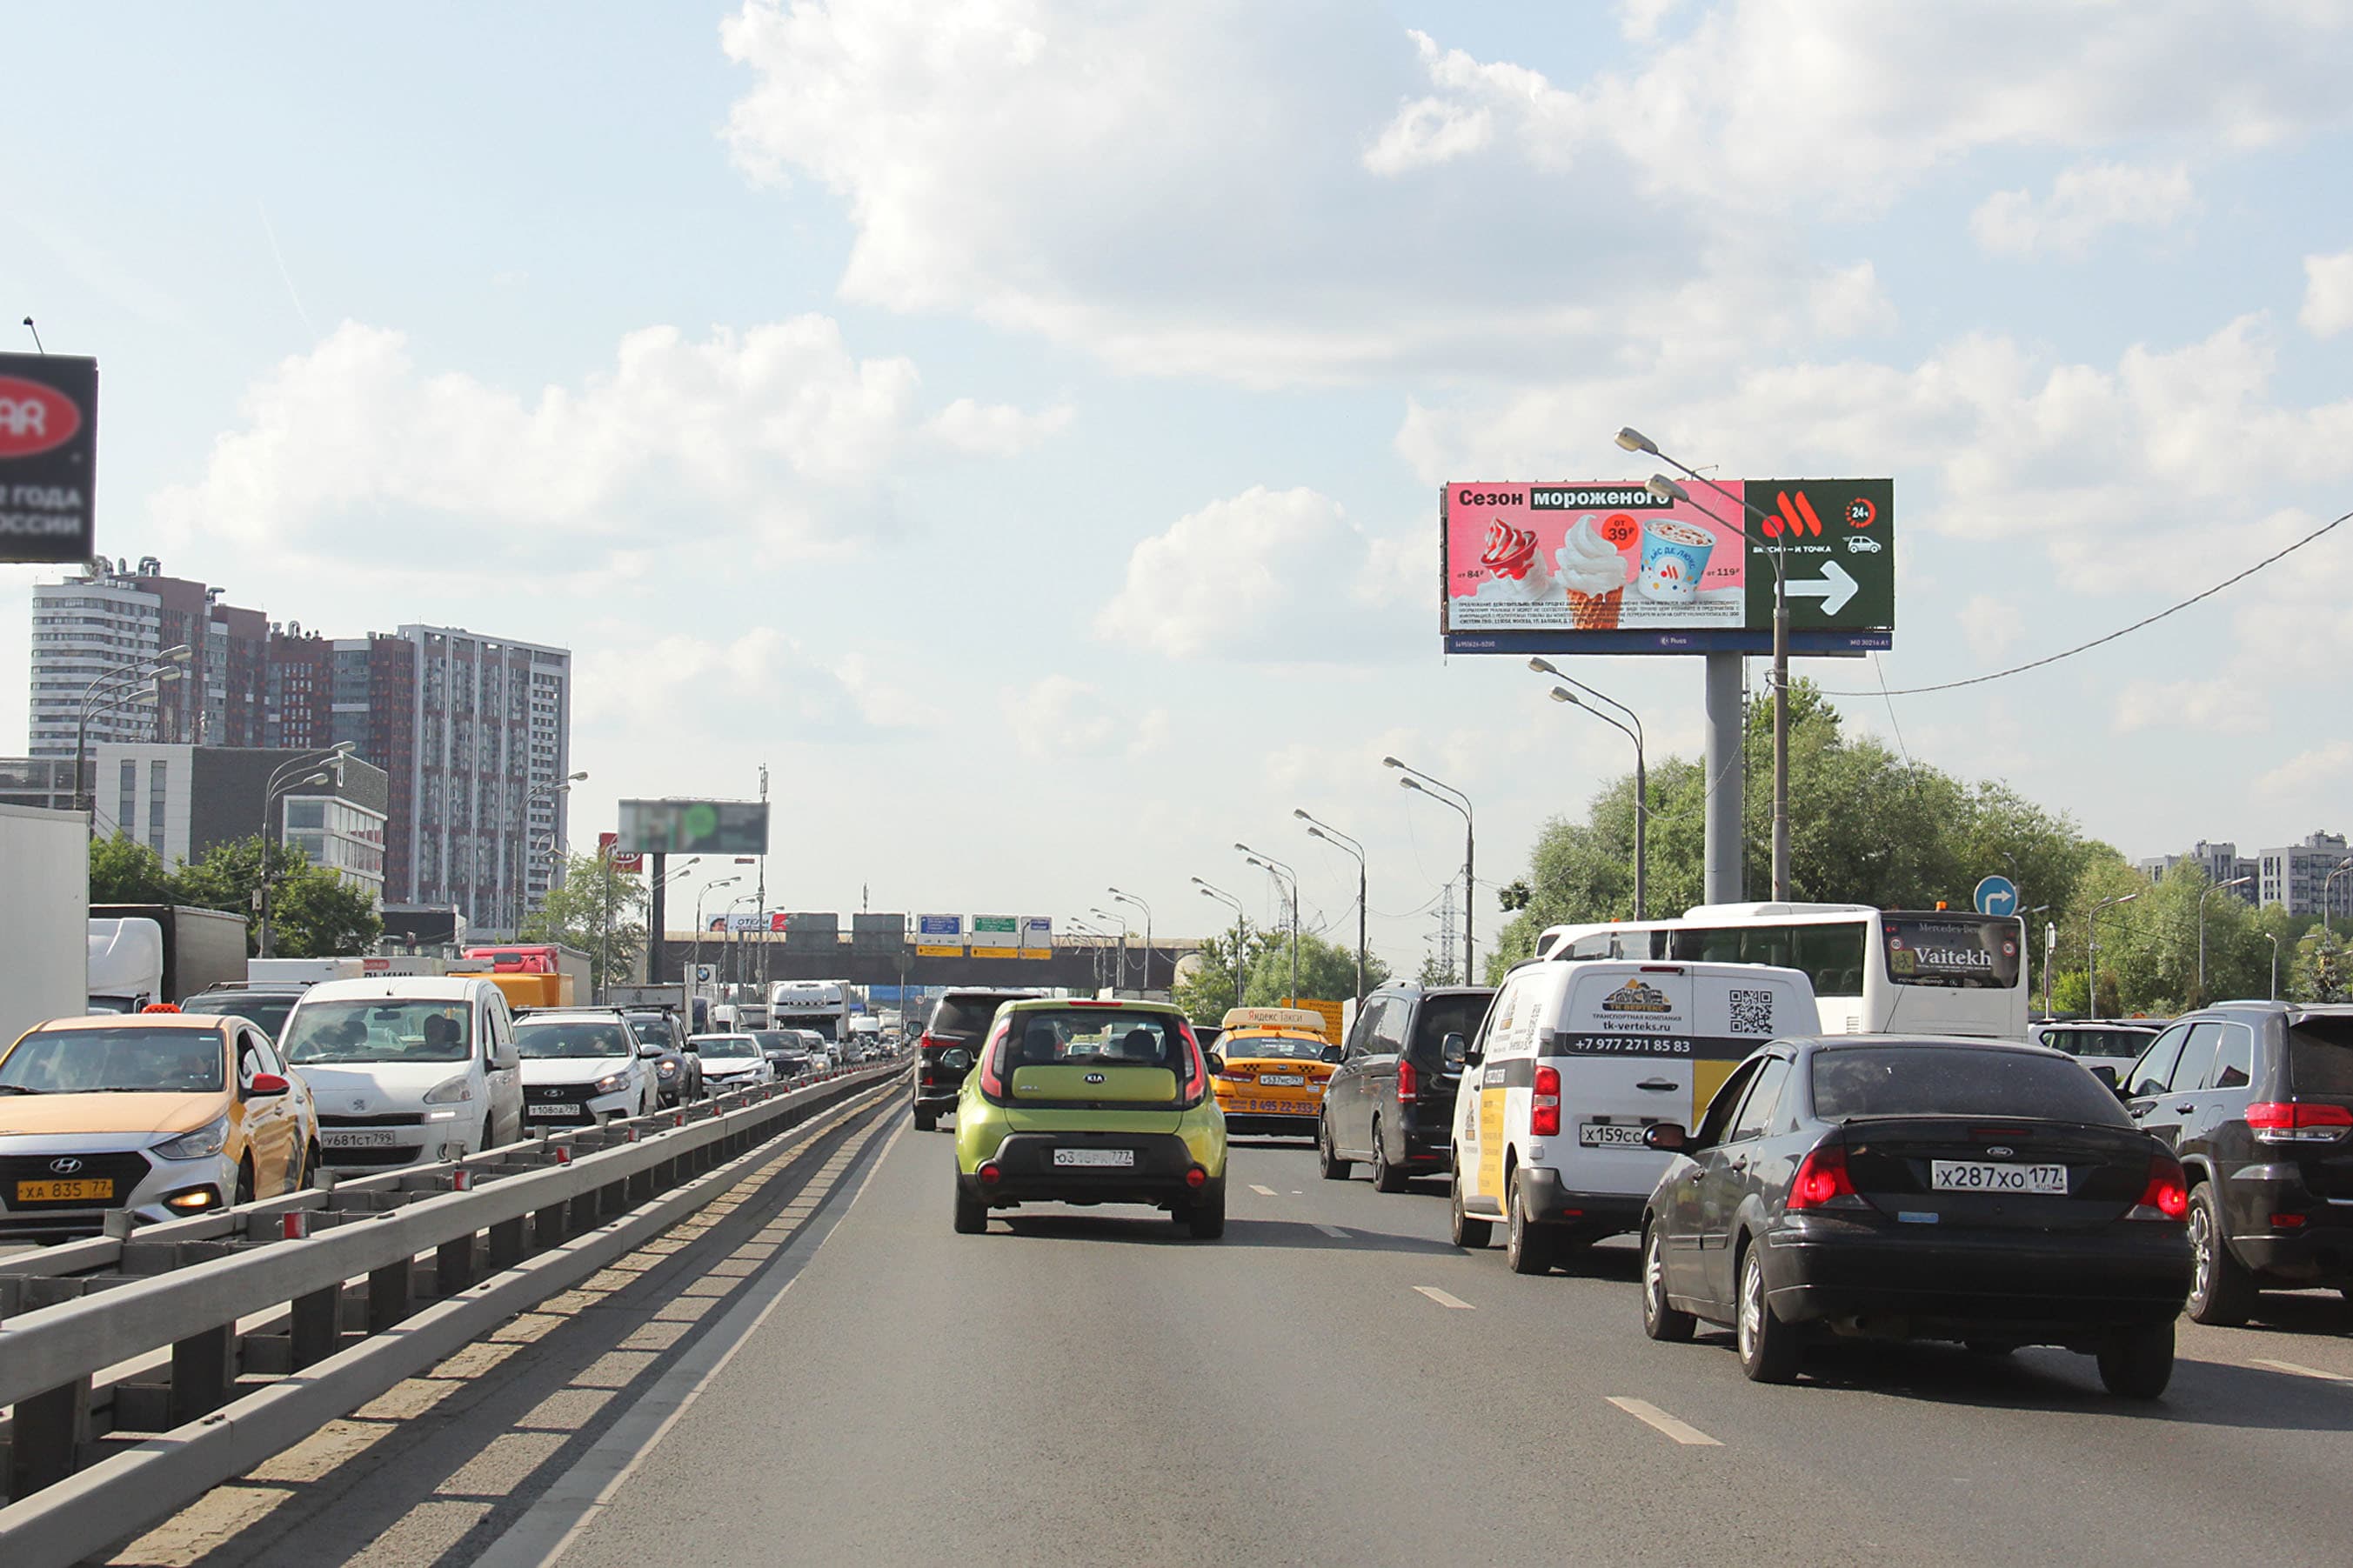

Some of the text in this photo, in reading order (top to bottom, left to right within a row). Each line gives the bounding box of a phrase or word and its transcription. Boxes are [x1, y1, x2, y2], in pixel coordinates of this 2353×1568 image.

[13, 484, 83, 510] ГОДА
[1459, 490, 1523, 505] Сезон
[1918, 922, 1980, 933] Mercedes-Ben
[1914, 947, 1991, 966] Vaitekh
[1248, 1011, 1303, 1023] Яндекс Такси
[1603, 1021, 1671, 1031] tk-verteks.ru
[1575, 1038, 1690, 1052] +7 977 271 85 83
[2029, 1167, 2059, 1184] 177
[52, 1183, 82, 1198] 835
[91, 1180, 107, 1192] 77
